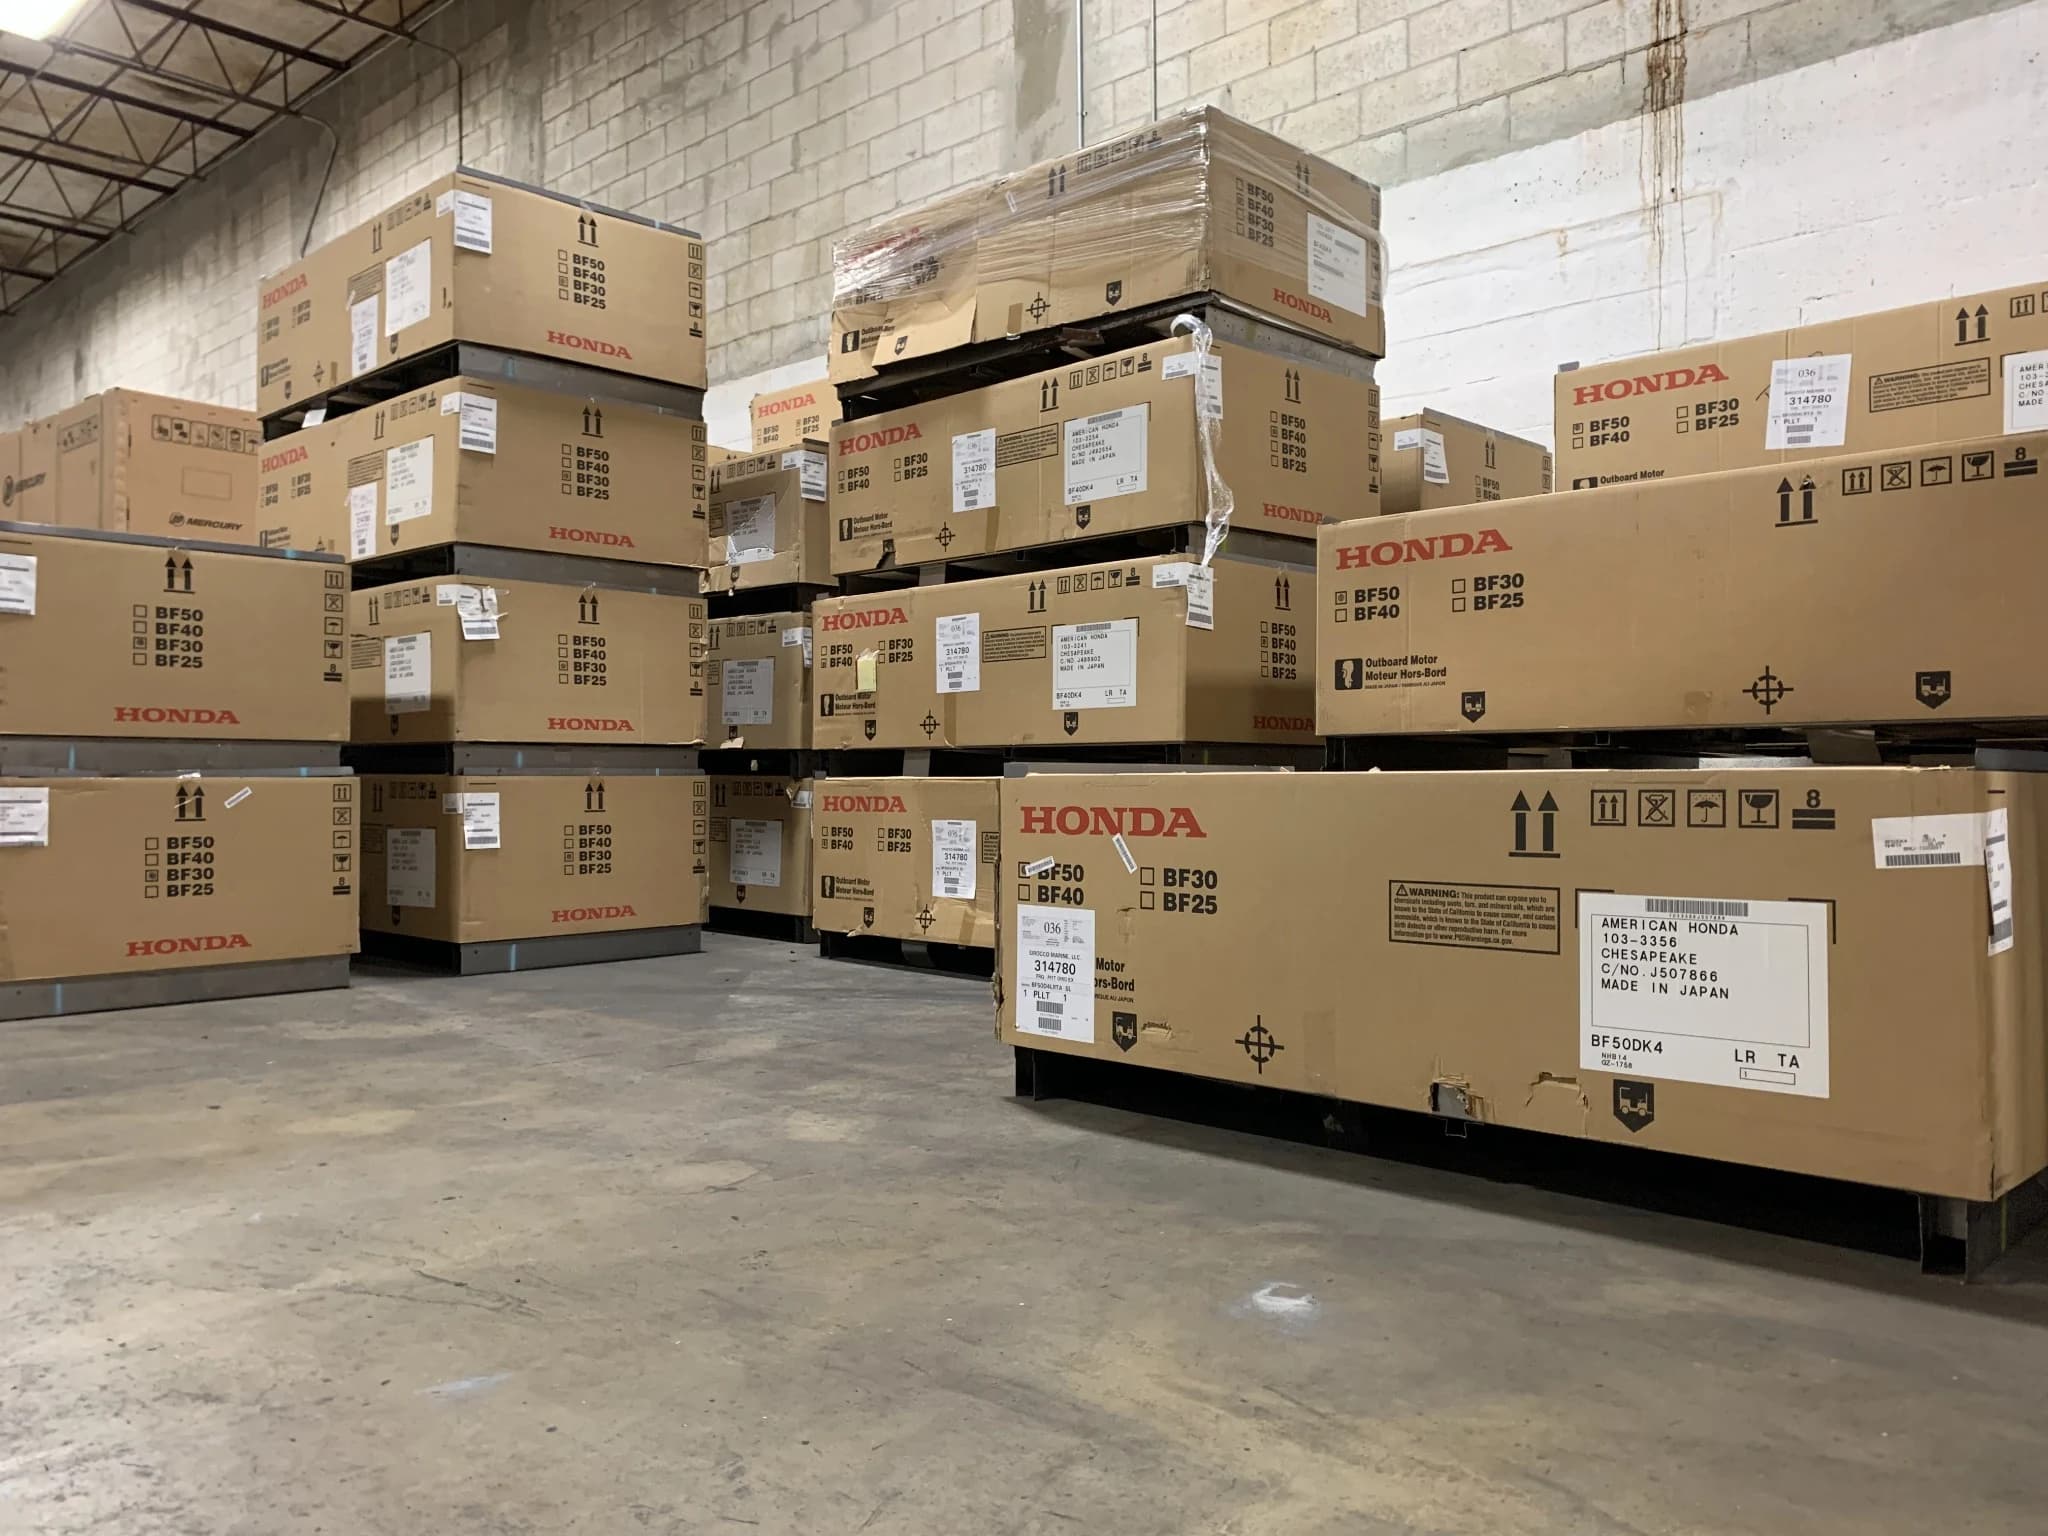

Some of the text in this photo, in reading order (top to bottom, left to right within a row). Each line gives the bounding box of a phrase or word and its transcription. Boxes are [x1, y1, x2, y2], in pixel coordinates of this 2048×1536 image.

[1247, 182, 1274, 204] BF50
[1247, 197, 1274, 219] BF40
[1247, 213, 1274, 233] BF30
[1247, 228, 1274, 248] BF25
[572, 253, 606, 272] BF50
[573, 266, 606, 284] BF40
[262, 273, 308, 310] HONDA
[573, 279, 607, 297] BF30
[573, 292, 607, 310] BF25
[1272, 288, 1333, 324] HONDA
[547, 330, 633, 360] HONDA
[1798, 368, 1816, 377] 036
[1573, 363, 1729, 406] HONDA
[758, 393, 816, 419] HONDA
[1695, 398, 1739, 416] BF30
[1789, 394, 1832, 406] 314780
[2018, 398, 2043, 406] MADE
[1280, 413, 1306, 430] BF50
[1589, 416, 1630, 433] BF50
[1695, 413, 1739, 431] BF25
[839, 422, 923, 457] HONDA
[1281, 428, 1306, 444] BF40
[1589, 430, 1630, 447] BF40
[576, 446, 610, 462] BF50
[1281, 442, 1306, 459] BF30
[2015, 447, 2026, 460] 8
[262, 445, 308, 474] HONDA
[576, 459, 610, 475] BF40
[904, 453, 928, 467] BF30
[1282, 457, 1307, 473] BF25
[576, 472, 610, 488] BF30
[847, 466, 870, 480] BF50
[904, 466, 928, 480] BF25
[1600, 468, 1665, 485] Outboard Motor
[576, 485, 610, 501] BF25
[847, 478, 870, 492] BF40
[186, 517, 243, 531] MERCURY
[549, 526, 636, 549] HONDA
[1336, 529, 1512, 570] HONDA
[1473, 573, 1524, 592] BF30
[1354, 586, 1400, 603] BF50
[1473, 592, 1524, 611] BF25
[155, 606, 204, 622] BF50
[822, 607, 908, 631] HONDA
[1354, 604, 1400, 621] BF40
[155, 622, 204, 637] BF40
[1271, 622, 1296, 637] BF50
[155, 638, 204, 653] BF30
[572, 635, 607, 648] BF50
[830, 644, 853, 654] BF50
[888, 638, 914, 650] BF30
[1271, 637, 1296, 651] BF40
[155, 654, 203, 669] BF25
[573, 648, 607, 661] BF40
[830, 656, 853, 668] BF40
[888, 651, 913, 663] BF25
[1271, 652, 1296, 666] BF30
[1365, 655, 1438, 668] Outboard Motor
[573, 661, 607, 673] BF30
[1272, 666, 1297, 680] BF25
[1365, 667, 1447, 681] Moteur Hors-Bord
[573, 674, 607, 687] BF25
[113, 706, 240, 726] HONDA
[1252, 715, 1316, 732] HONDA
[547, 717, 635, 732] HONDA
[822, 795, 907, 813] HONDA
[1806, 789, 1821, 808] 8
[1020, 805, 1207, 838] HONDA
[578, 824, 612, 836] BF50
[831, 827, 853, 838] BF50
[887, 827, 912, 839] BF30
[167, 836, 214, 850] BF50
[578, 837, 612, 849] BF40
[831, 839, 853, 851] BF40
[887, 840, 912, 852] BF25
[167, 852, 214, 866] BF40
[578, 850, 612, 862] BF30
[944, 852, 968, 861] 314780
[167, 868, 214, 882] BF30
[578, 863, 612, 875] BF25
[1038, 863, 1085, 882] BF50
[1163, 868, 1218, 889] BF30
[167, 883, 214, 897] BF25
[1038, 885, 1085, 905] BF40
[1408, 887, 1460, 899] WARNING:
[1163, 892, 1218, 915] BF25
[551, 904, 638, 923] HONDA
[1044, 922, 1061, 934] 036
[1601, 917, 1678, 933] AMERICAN
[1688, 922, 1739, 936] HONDA
[126, 934, 252, 957] HONDA
[1602, 933, 1678, 948] 103-3356
[1096, 957, 1125, 972] Motor
[1601, 948, 1697, 965] CHESAPEAKE
[1034, 960, 1076, 975] 314780
[1033, 990, 1050, 999] PLLT
[1601, 978, 1730, 1000] MADE IN JAPAN
[1591, 1034, 1663, 1054] BF50DK4
[1734, 1048, 1800, 1068] LR TA
